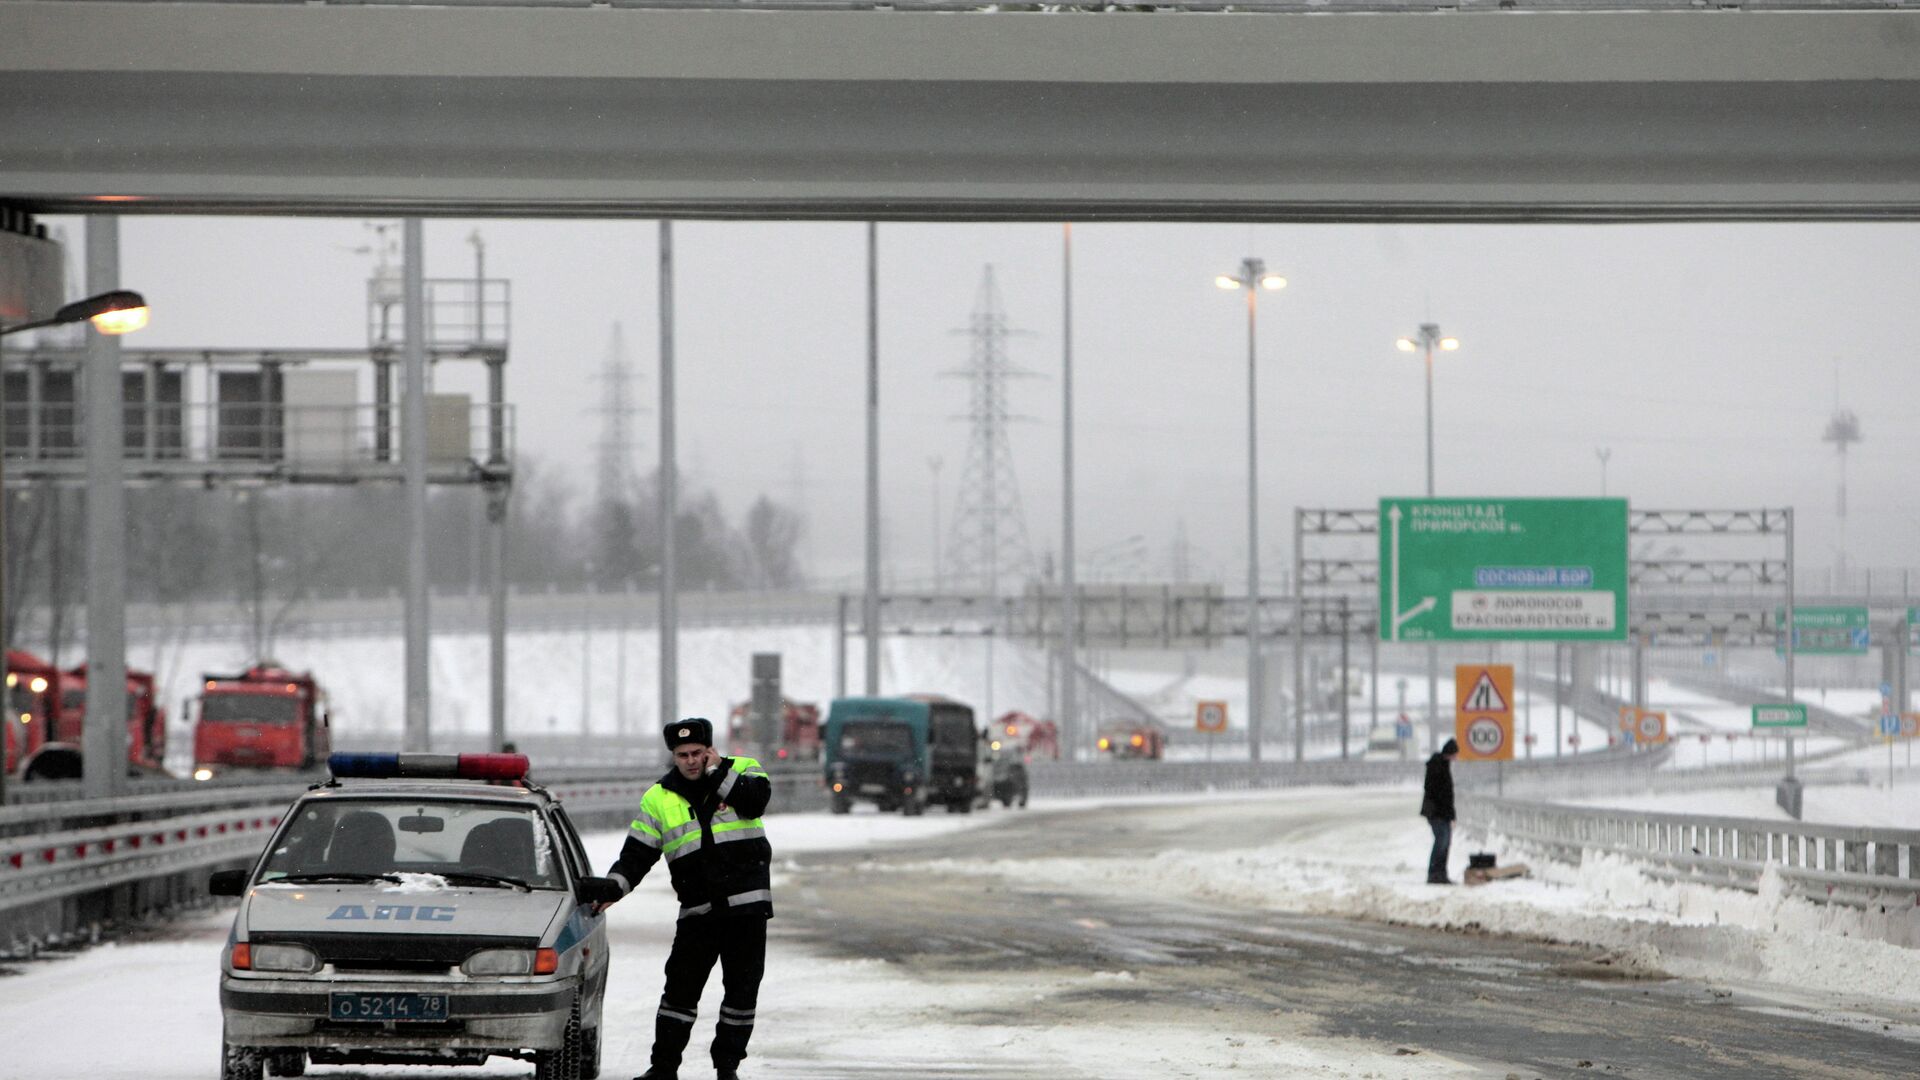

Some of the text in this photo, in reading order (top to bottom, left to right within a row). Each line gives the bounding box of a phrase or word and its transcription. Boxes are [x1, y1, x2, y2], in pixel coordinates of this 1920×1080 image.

[1411, 504, 1504, 517] КРОНШТАДТ
[1411, 519, 1505, 532] ПРИМОРСКОЕ
[1478, 568, 1589, 583] СОСНОВЫЙ БОР
[1495, 597, 1583, 609] ЛОМОНОСОВ
[1456, 613, 1592, 626] КРАСНОФЛОТСКОЕ
[1472, 727, 1498, 745] 100
[326, 905, 457, 921] ДПС
[360, 997, 409, 1015] 5214
[421, 997, 441, 1010] 78
